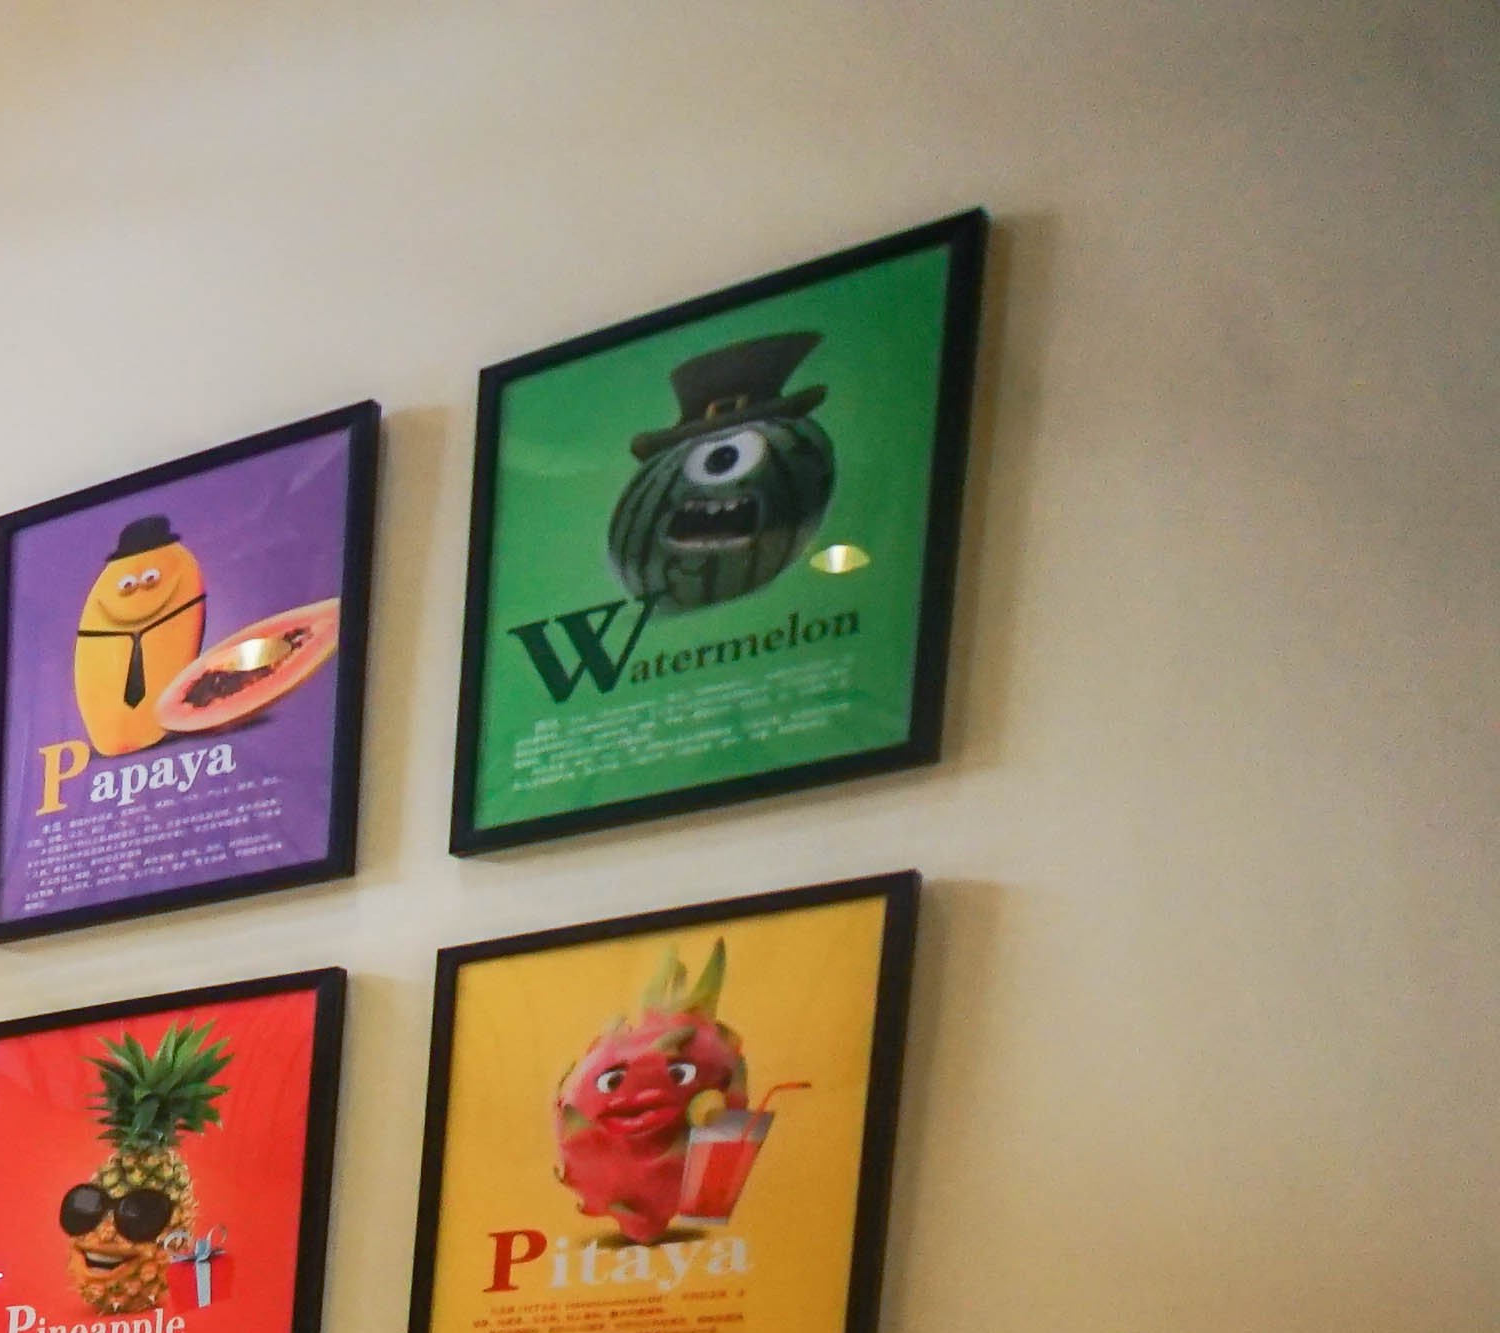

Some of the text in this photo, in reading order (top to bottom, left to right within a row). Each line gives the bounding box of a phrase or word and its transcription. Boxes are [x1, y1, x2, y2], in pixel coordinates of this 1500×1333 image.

[507, 593, 860, 704] Watermelon
[35, 740, 236, 816] Papaya
[483, 1228, 753, 1293] Pitaya
